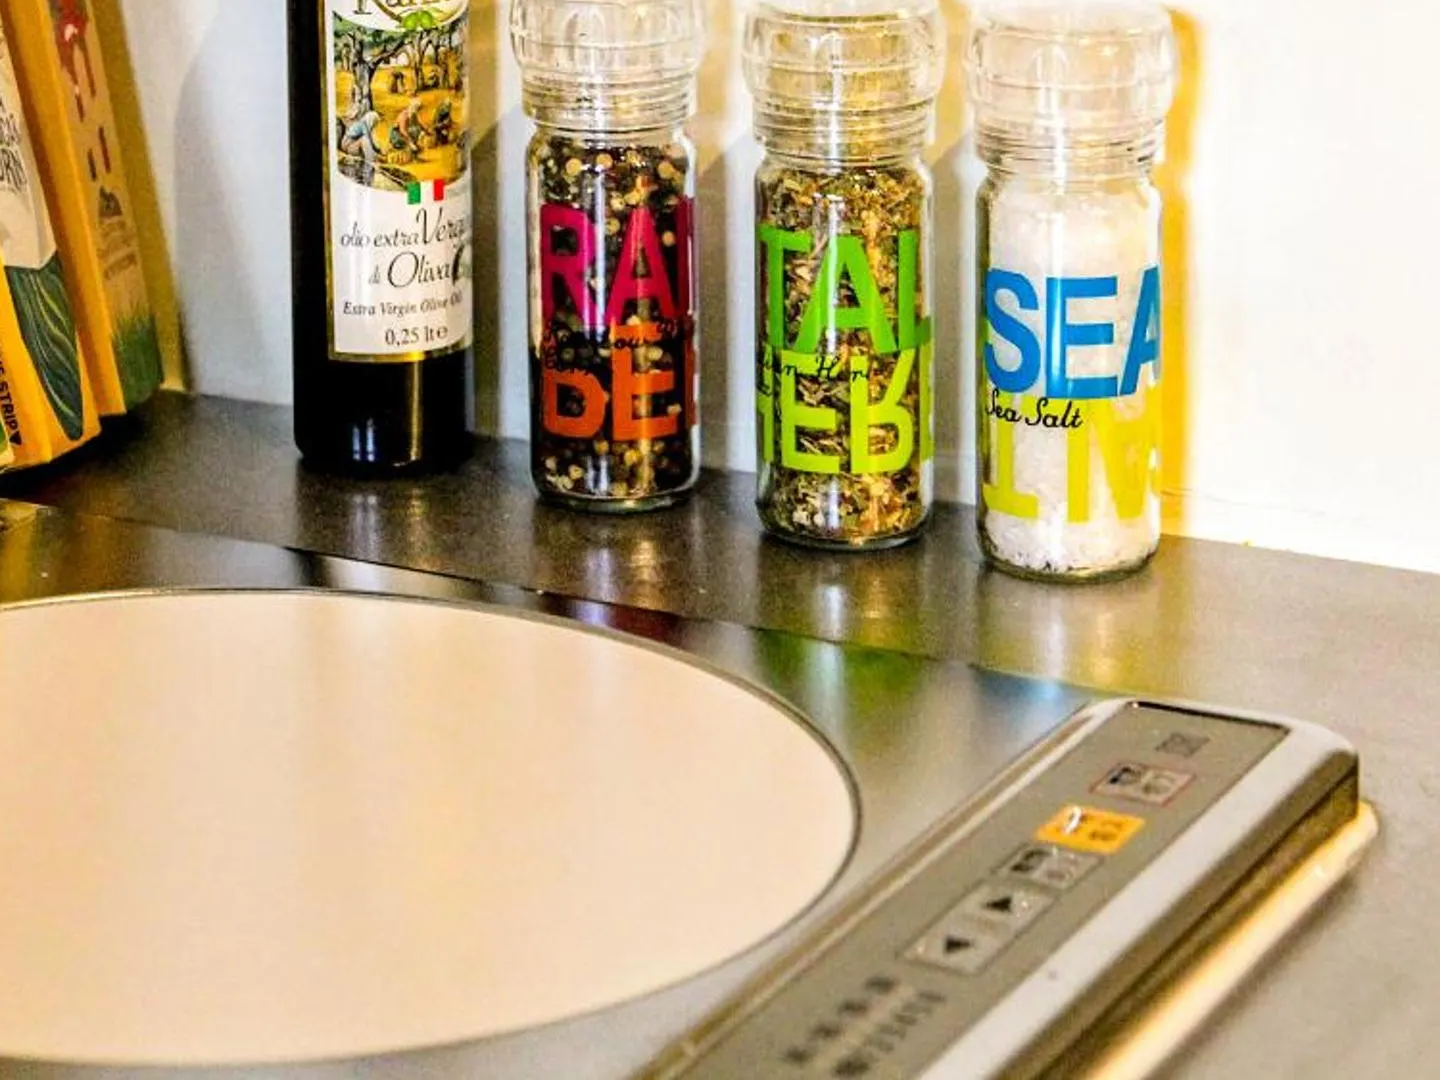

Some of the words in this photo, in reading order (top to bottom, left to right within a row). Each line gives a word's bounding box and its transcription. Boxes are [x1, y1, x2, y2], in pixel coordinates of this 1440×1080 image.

[373, 227, 419, 248] extra
[343, 301, 376, 316] Extra
[379, 299, 417, 318] Virgin
[420, 297, 448, 313] Olive
[384, 327, 420, 348] 0,25
[985, 388, 1021, 422] Sea
[1024, 397, 1083, 428] Salt
